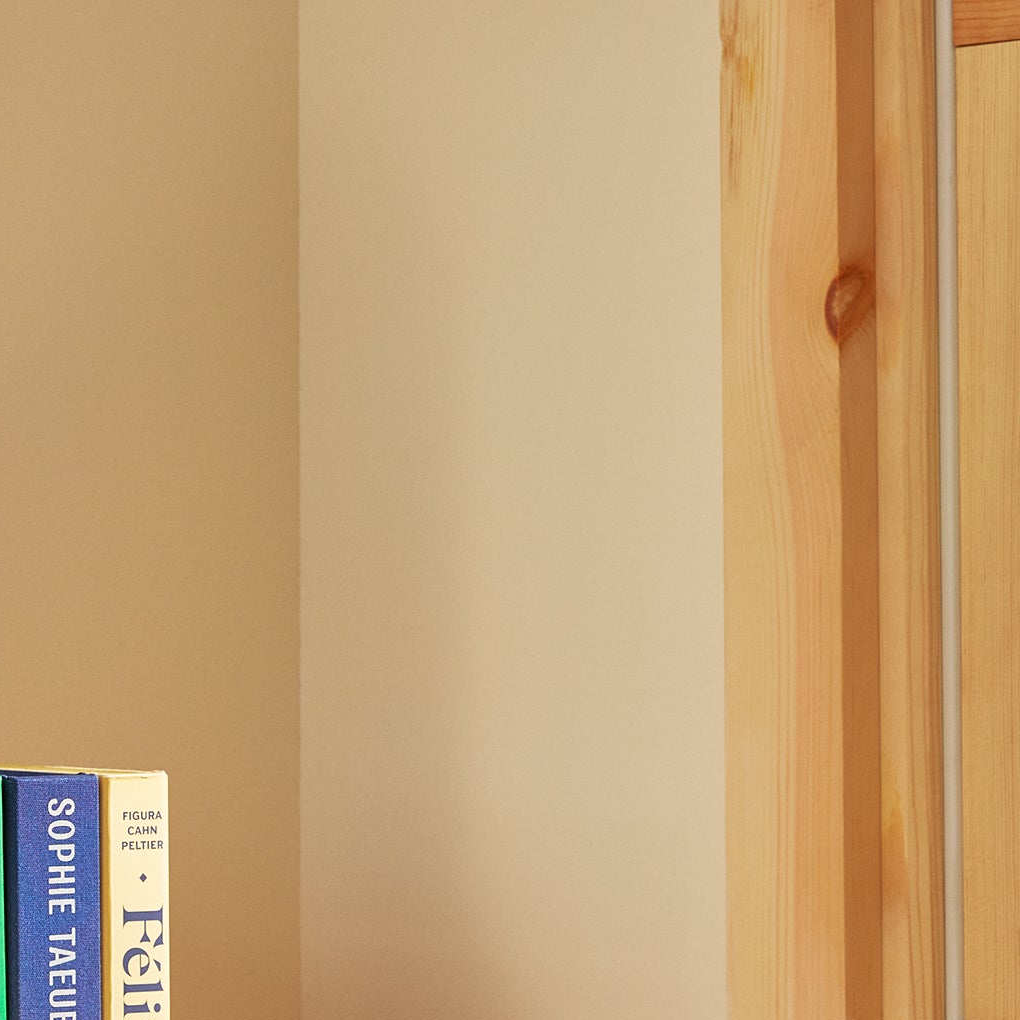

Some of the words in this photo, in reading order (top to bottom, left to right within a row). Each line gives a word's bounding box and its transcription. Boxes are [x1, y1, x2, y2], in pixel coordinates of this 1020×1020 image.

[122, 811, 163, 821] FIGURA
[127, 825, 157, 836] CAHN
[121, 840, 164, 851] PELTIER
[47, 797, 76, 915] SOPHIE
